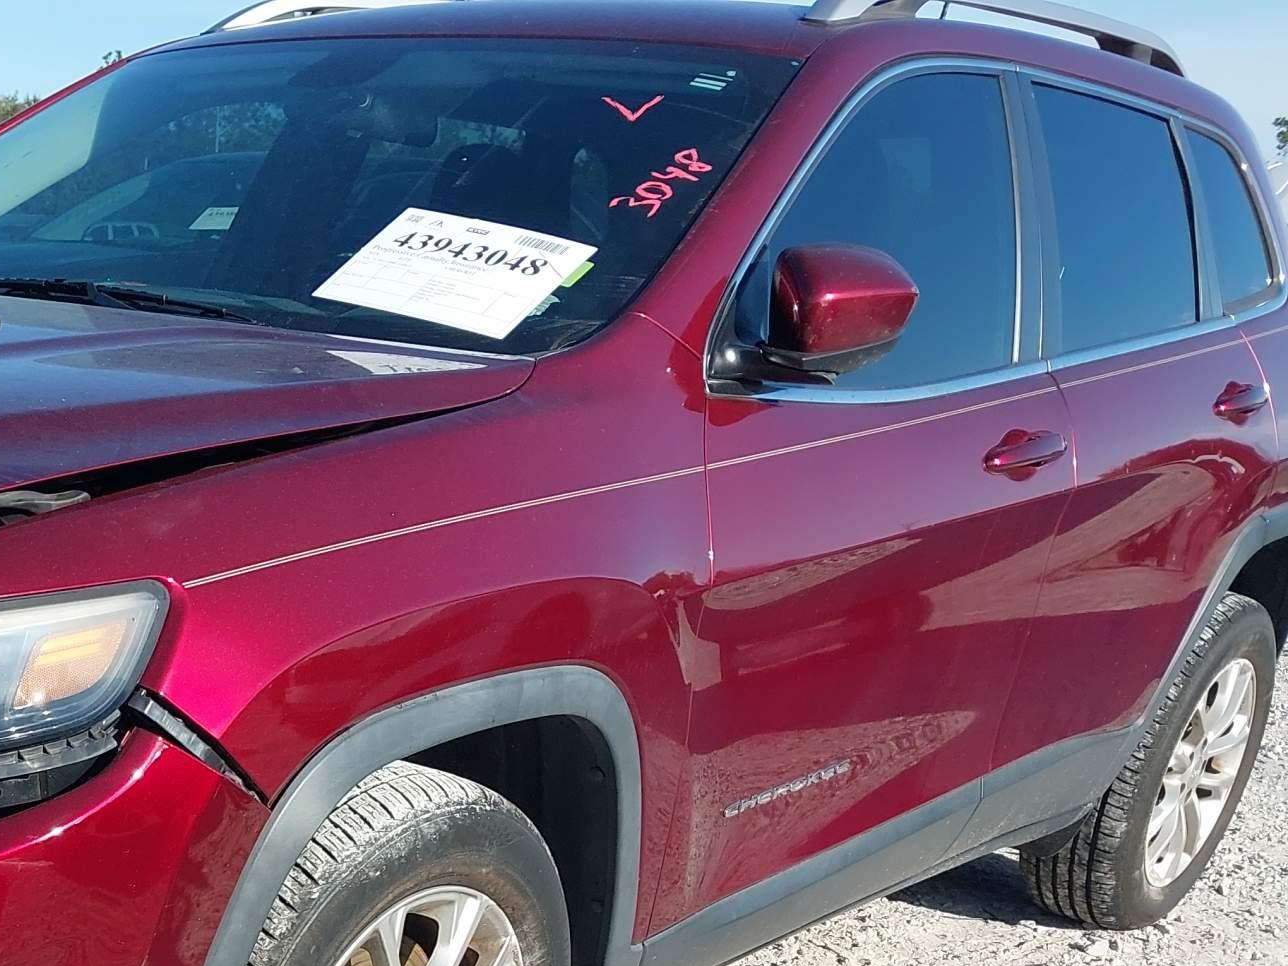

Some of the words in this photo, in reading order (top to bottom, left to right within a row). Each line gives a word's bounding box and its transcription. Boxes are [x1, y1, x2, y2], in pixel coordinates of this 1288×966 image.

[609, 148, 713, 218] 3048
[393, 231, 548, 277] 43943048
[724, 757, 852, 819] CHEROKEE
